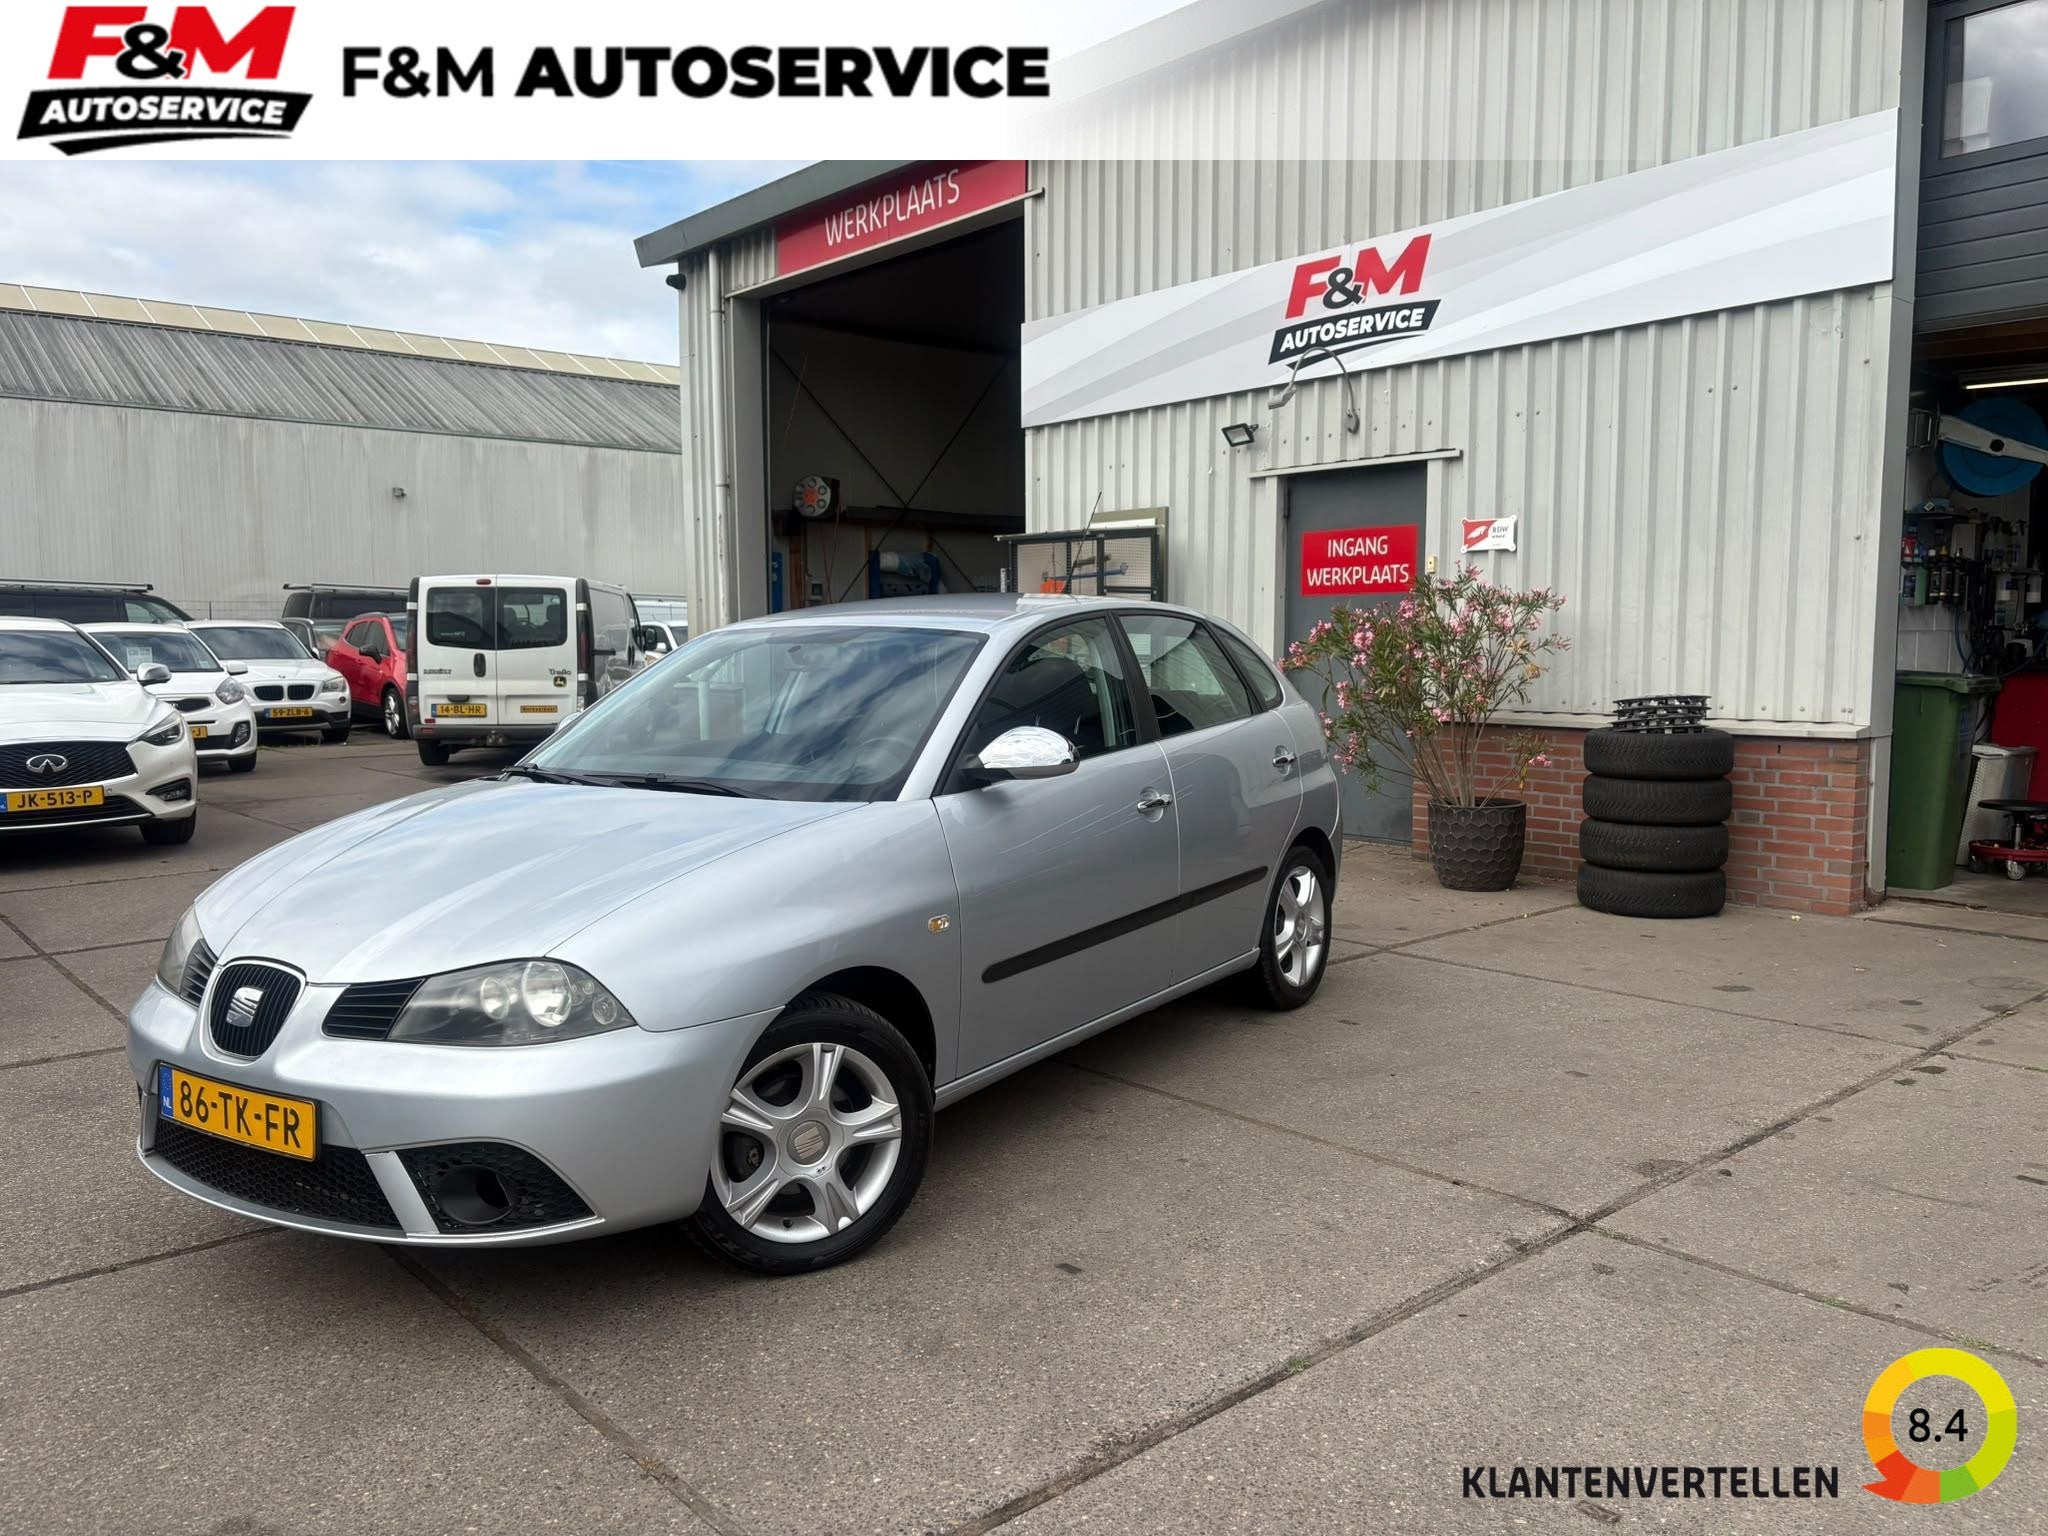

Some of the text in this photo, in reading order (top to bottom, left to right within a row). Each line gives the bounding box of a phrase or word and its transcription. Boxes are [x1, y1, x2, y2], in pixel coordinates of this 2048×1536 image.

[825, 169, 960, 246] WERKPLAATS
[1285, 233, 1432, 319] F&M
[1280, 308, 1425, 352] AUTOSERVICE
[1328, 536, 1388, 557] INGANG
[1307, 564, 1409, 586] WERKPLAATS
[440, 705, 481, 714] 14-BL-HR
[17, 790, 92, 808] JK-513-P
[180, 1080, 300, 1148] 86-TK-FR
